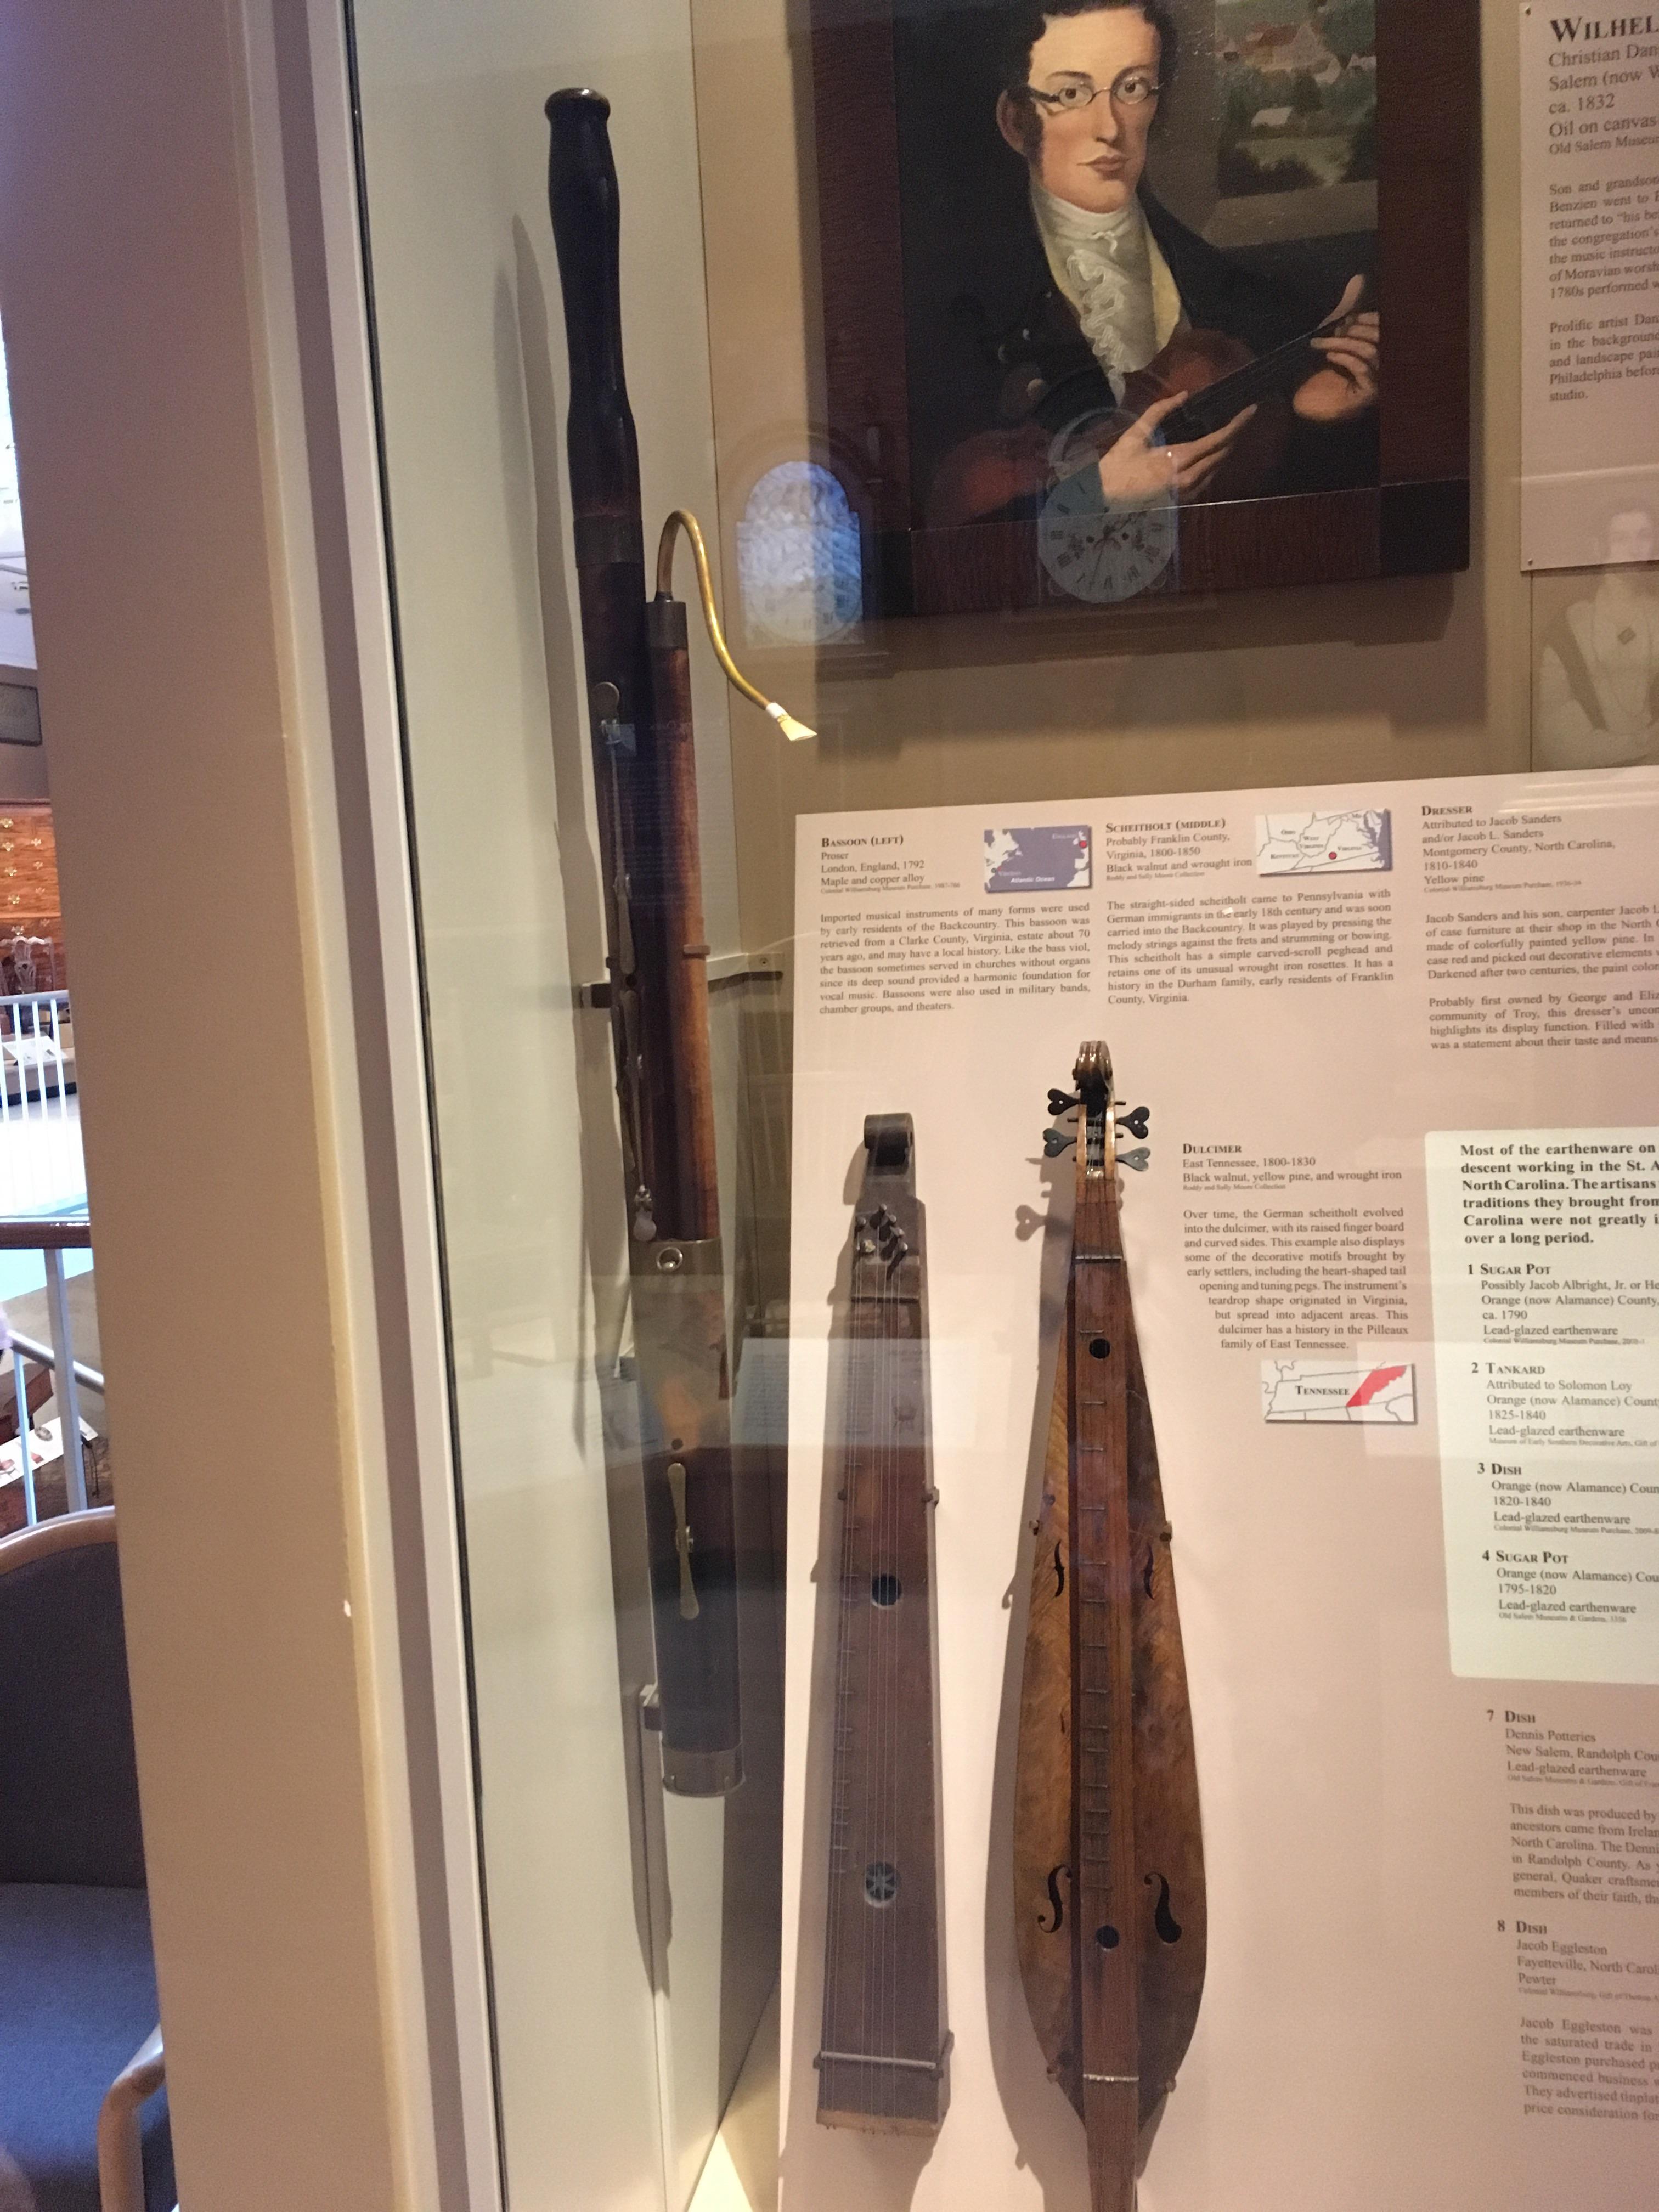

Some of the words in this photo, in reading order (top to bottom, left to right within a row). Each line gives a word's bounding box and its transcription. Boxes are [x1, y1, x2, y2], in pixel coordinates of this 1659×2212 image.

[1422, 818, 1473, 830] Attributed
[1476, 817, 1486, 827] to
[1489, 816, 1518, 826] Jacob
[1521, 814, 1562, 825] Sanders
[1105, 835, 1147, 848] Probably
[1150, 833, 1190, 844] Franklin
[1421, 833, 1454, 843] and/or
[1457, 831, 1486, 841] Jacob
[1503, 828, 1544, 839] Sanders
[821, 851, 849, 860] Proser
[1150, 845, 1200, 856] 1800-1850
[1423, 845, 1487, 859] Montgomery
[1534, 841, 1564, 851] North
[904, 859, 924, 869] 1792
[1106, 862, 1132, 872] Black
[1136, 861, 1167, 871] walnut
[1171, 860, 1188, 870] and
[1191, 858, 1230, 871] wrought
[1233, 857, 1252, 867] iron
[1424, 860, 1477, 871] 1810-1840
[821, 876, 848, 888] Maple
[851, 875, 867, 884] and
[870, 876, 899, 886] copper
[902, 872, 924, 884] alloy
[1424, 874, 1458, 884] Yellow
[1463, 873, 1485, 885] pine
[1107, 900, 1125, 910] The
[1130, 897, 1194, 911] straight-sided
[1199, 895, 1246, 906] scheitholt
[1282, 893, 1292, 902] to
[1297, 890, 1363, 904] Pennsylvania
[1369, 889, 1391, 899] with
[820, 912, 861, 924] Imported
[866, 910, 900, 921] musical
[906, 908, 958, 919] instruments
[963, 907, 973, 917] of
[978, 909, 1002, 918] many
[1008, 905, 1035, 915] forms
[1068, 902, 1090, 912] used
[819, 1003, 857, 1014] chamber
[897, 1002, 913, 1011] and
[1460, 1144, 1493, 1155] Most
[1500, 1144, 1513, 1155] of
[1519, 1144, 1539, 1154] the
[1545, 1142, 1632, 1154] earthenware
[1182, 1158, 1203, 1168] East
[1263, 1156, 1316, 1167] 1800-1830
[1183, 1172, 1210, 1182] Black
[1252, 1171, 1285, 1184] yellow
[1316, 1171, 1334, 1181] and
[1337, 1170, 1378, 1182] wrought
[1381, 1170, 1402, 1180] iron
[1462, 1180, 1502, 1190] North
[1574, 1178, 1598, 1189] The
[1601, 1178, 1656, 1189] artisans
[1183, 1209, 1207, 1218] Over
[1243, 1208, 1258, 1218] the
[1263, 1207, 1304, 1217] German
[1309, 1207, 1357, 1217] scheitholt
[1363, 1207, 1403, 1217] evolved
[1511, 1233, 1540, 1245] long
[1468, 1265, 1472, 1274] 1
[1481, 1280, 1525, 1291] Possibly
[1529, 1280, 1559, 1289] Jacob
[1502, 1310, 1527, 1319] 1790
[1483, 1325, 1549, 1337] Lead-glazed
[1552, 1325, 1618, 1335] earthenware
[1221, 1339, 1252, 1351] family
[1256, 1339, 1267, 1348] of
[1270, 1339, 1291, 1348] East
[1471, 1363, 1478, 1373] 2
[1486, 1379, 1541, 1389] Attributed
[1544, 1380, 1555, 1390] to
[1558, 1380, 1607, 1390] Solomon
[1611, 1381, 1631, 1393] Loy
[1489, 1410, 1546, 1420] 1825-1840
[1489, 1426, 1555, 1438] Lead-glazed
[1558, 1426, 1624, 1436] earthenware
[1477, 1462, 1485, 1474] 3
[1494, 1497, 1551, 1506] 1820-1840
[1482, 1550, 1489, 1562] 4
[1499, 1584, 1556, 1595] 1795-1820
[1498, 1600, 1566, 1613] Lead-glazed
[1568, 1602, 1636, 1613] earthenware
